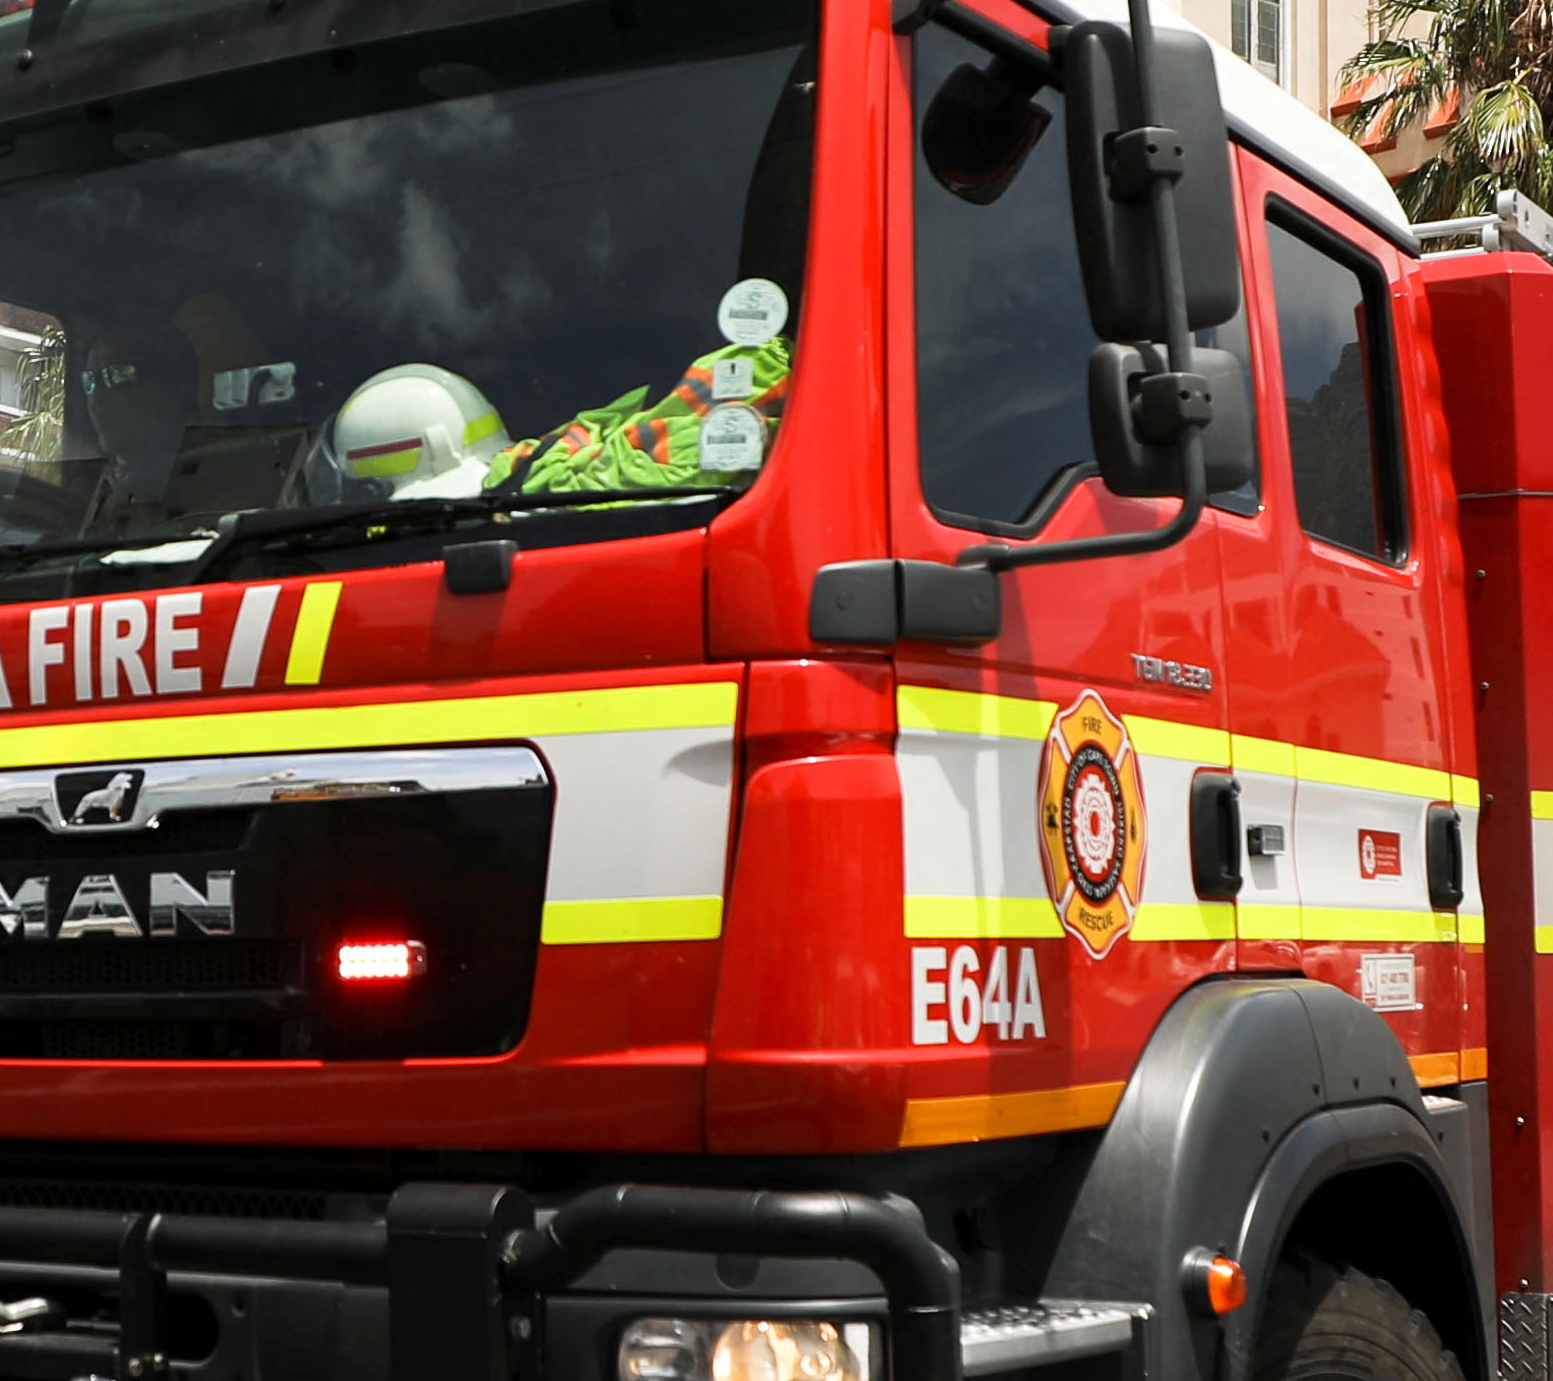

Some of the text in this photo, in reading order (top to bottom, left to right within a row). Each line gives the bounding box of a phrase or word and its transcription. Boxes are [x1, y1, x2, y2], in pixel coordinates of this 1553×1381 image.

[29, 591, 203, 706] FIRE
[1083, 716, 1103, 735] FIRE
[1080, 907, 1114, 932] RESCUE
[912, 945, 1046, 1045] E64A
